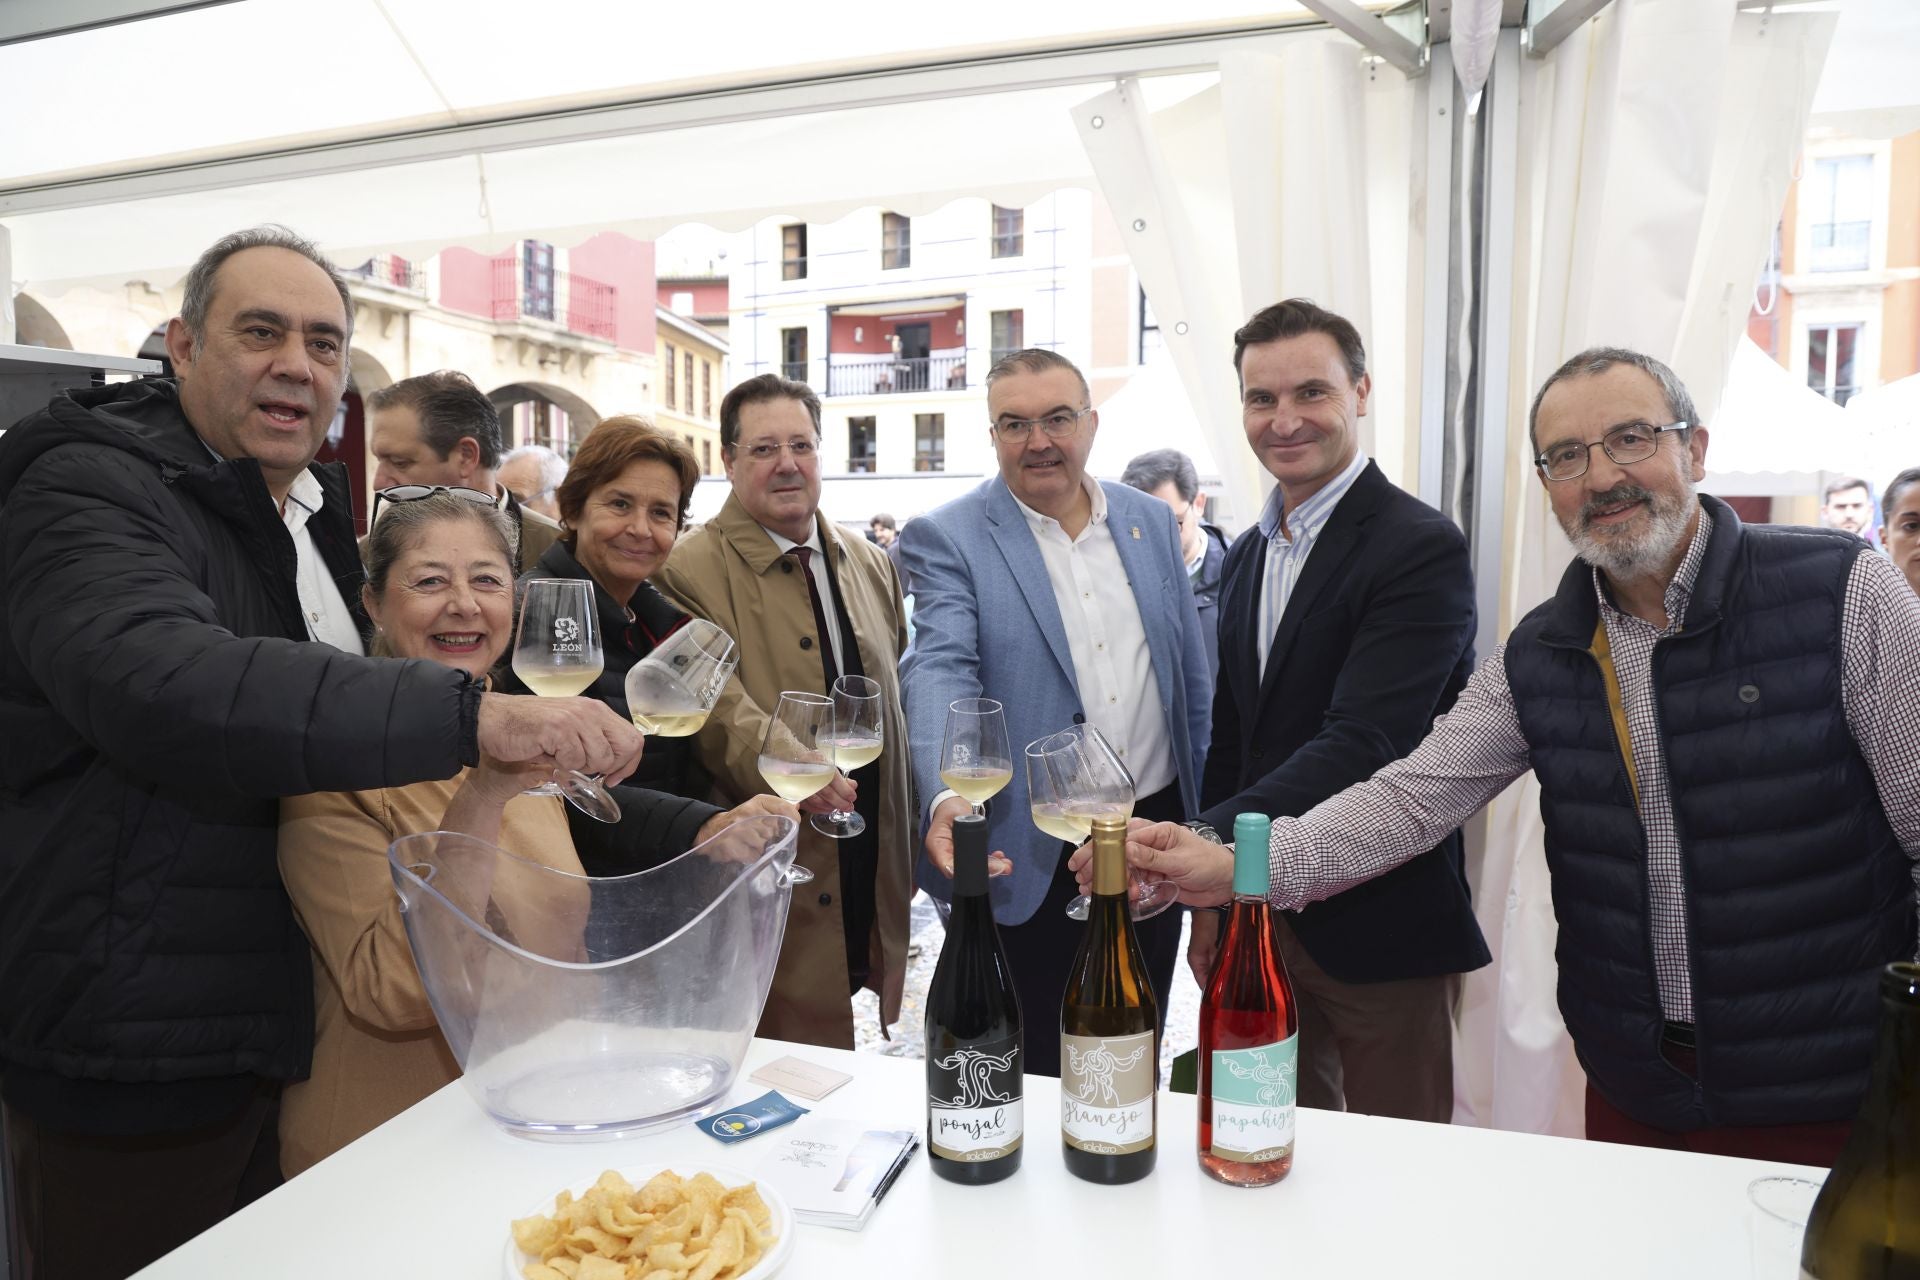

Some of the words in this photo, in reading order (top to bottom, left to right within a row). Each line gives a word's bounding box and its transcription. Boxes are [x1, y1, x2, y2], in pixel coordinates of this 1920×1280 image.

[552, 642, 583, 652] LEÓN
[939, 1108, 1006, 1141] ponjal
[1064, 1101, 1143, 1135] granejo
